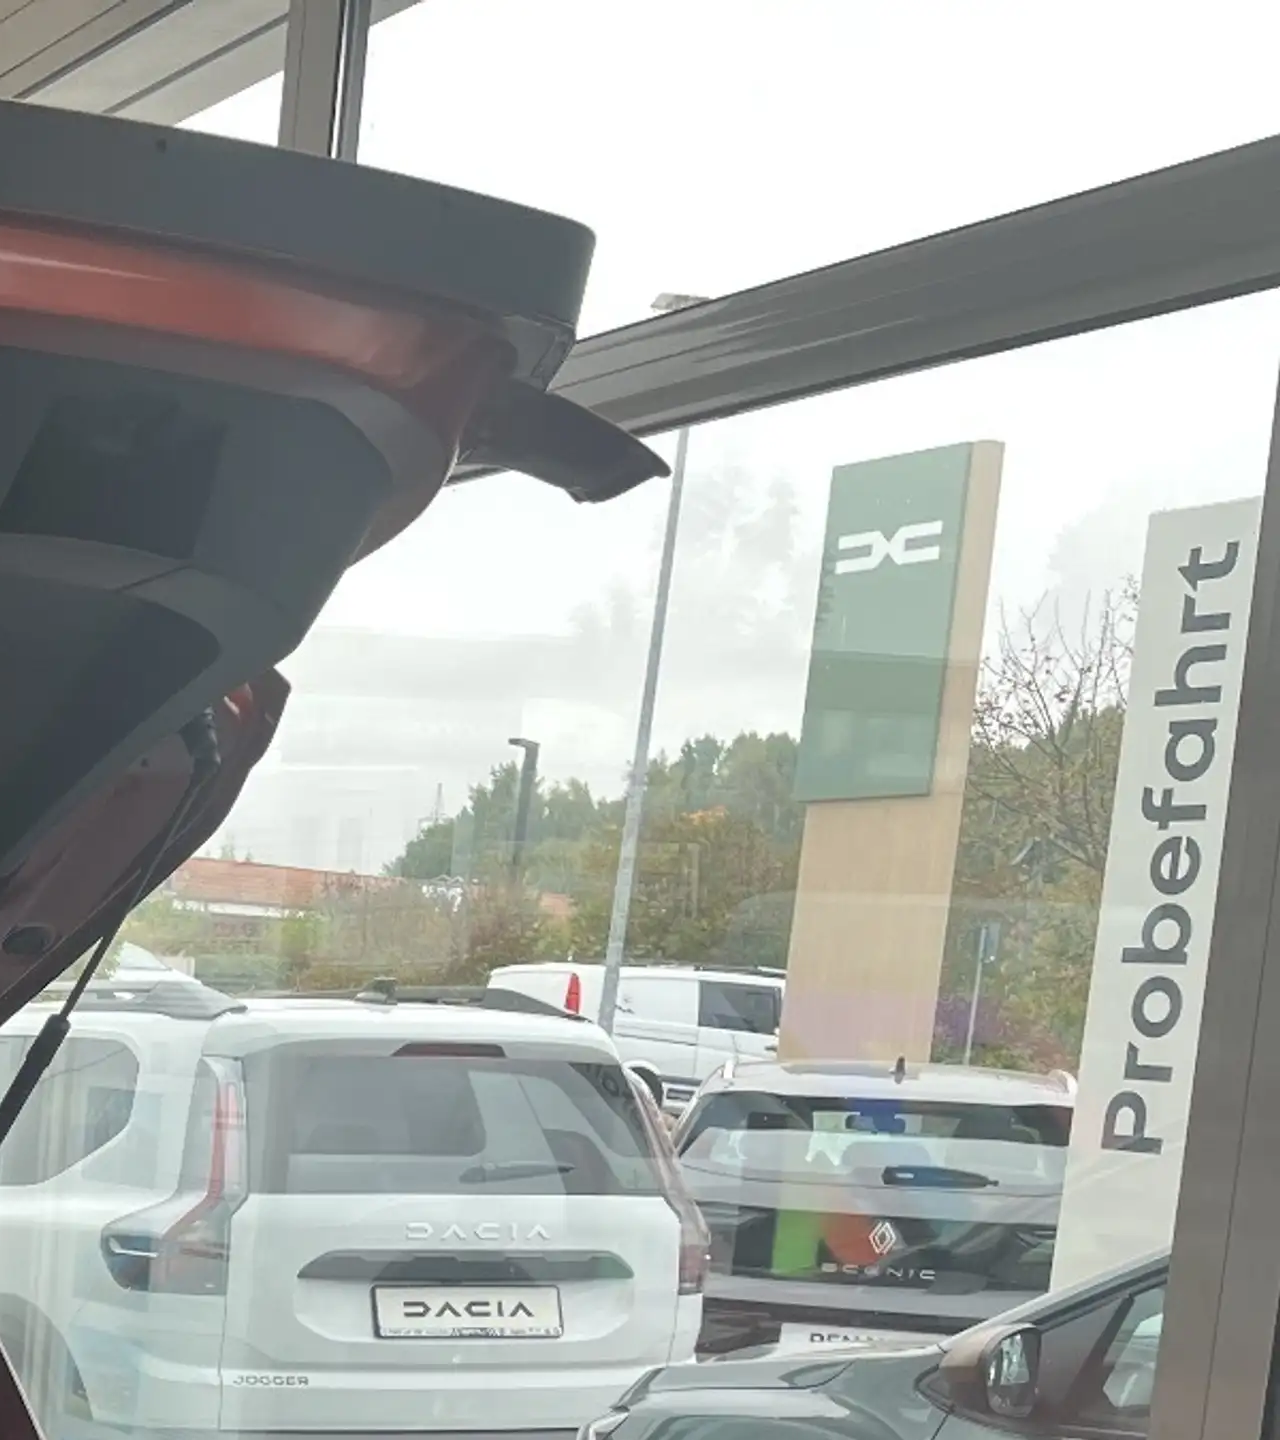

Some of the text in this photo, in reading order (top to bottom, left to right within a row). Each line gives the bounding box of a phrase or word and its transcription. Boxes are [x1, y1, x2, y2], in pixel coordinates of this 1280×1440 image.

[1100, 540, 1240, 1155] Probefahrt
[405, 1221, 552, 1242] DACIA
[402, 1301, 535, 1318] DACIA
[232, 1375, 310, 1387] JOGGER
